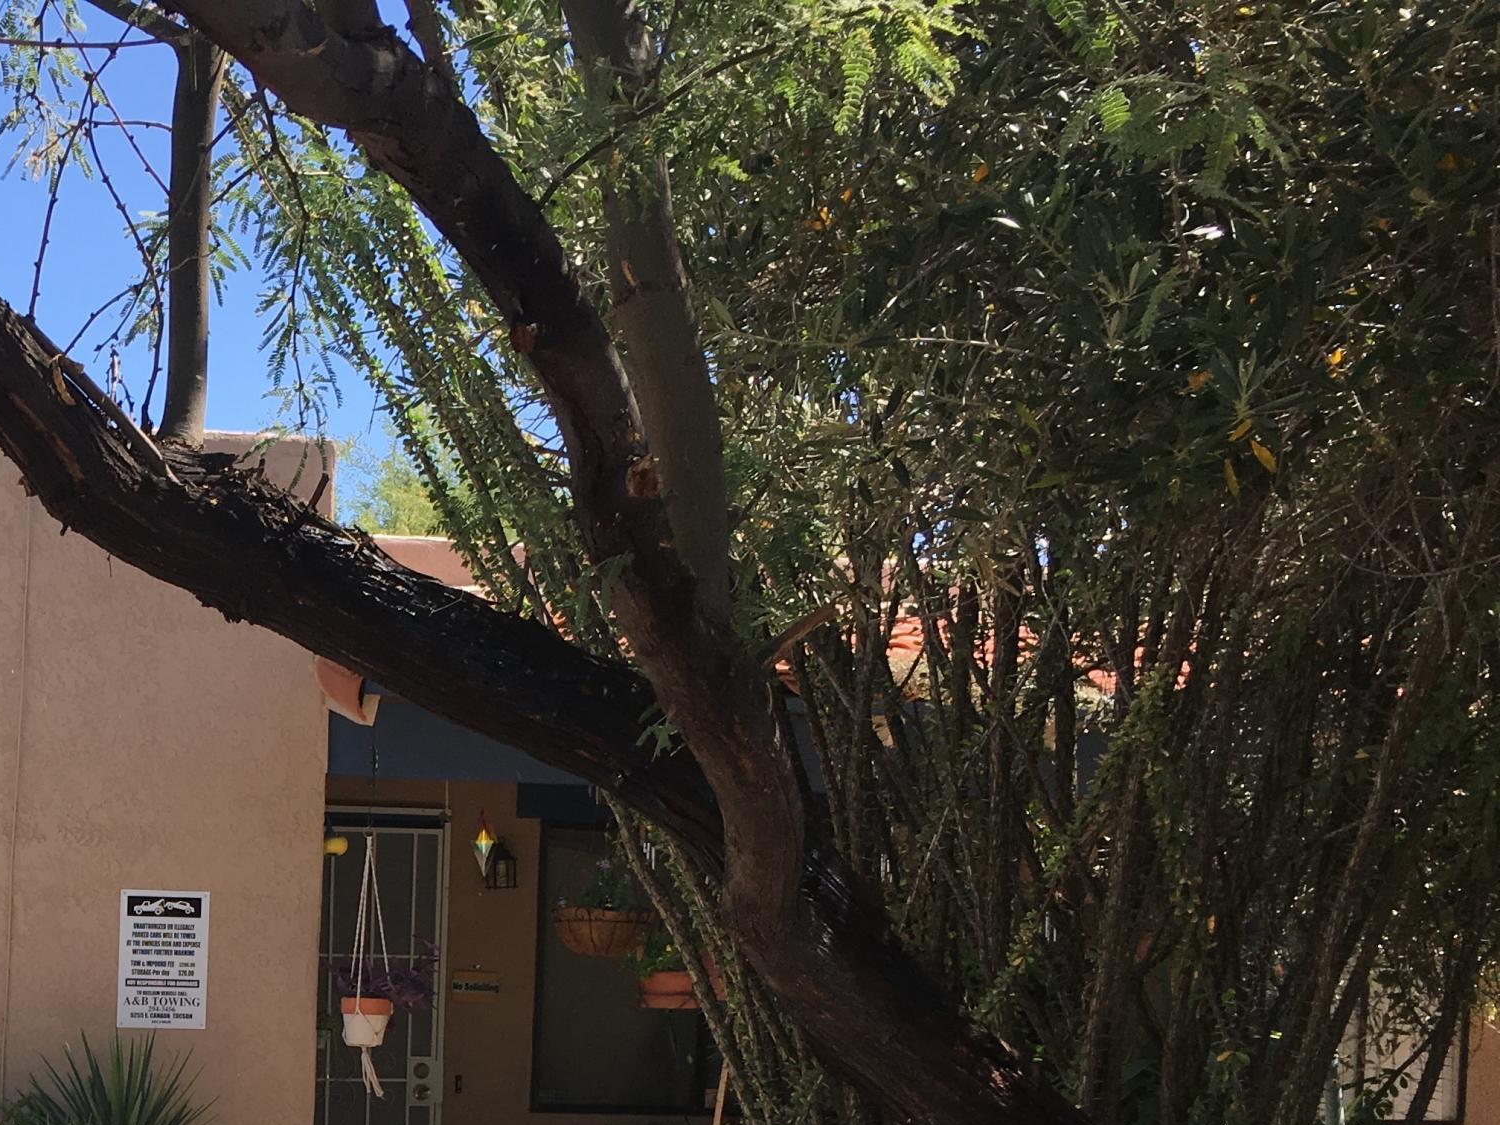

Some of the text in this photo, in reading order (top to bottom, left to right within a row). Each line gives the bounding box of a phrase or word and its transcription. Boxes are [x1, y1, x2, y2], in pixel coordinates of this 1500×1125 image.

[465, 983, 500, 993] Soliciting
[124, 996, 200, 1007] A&B TOWING
